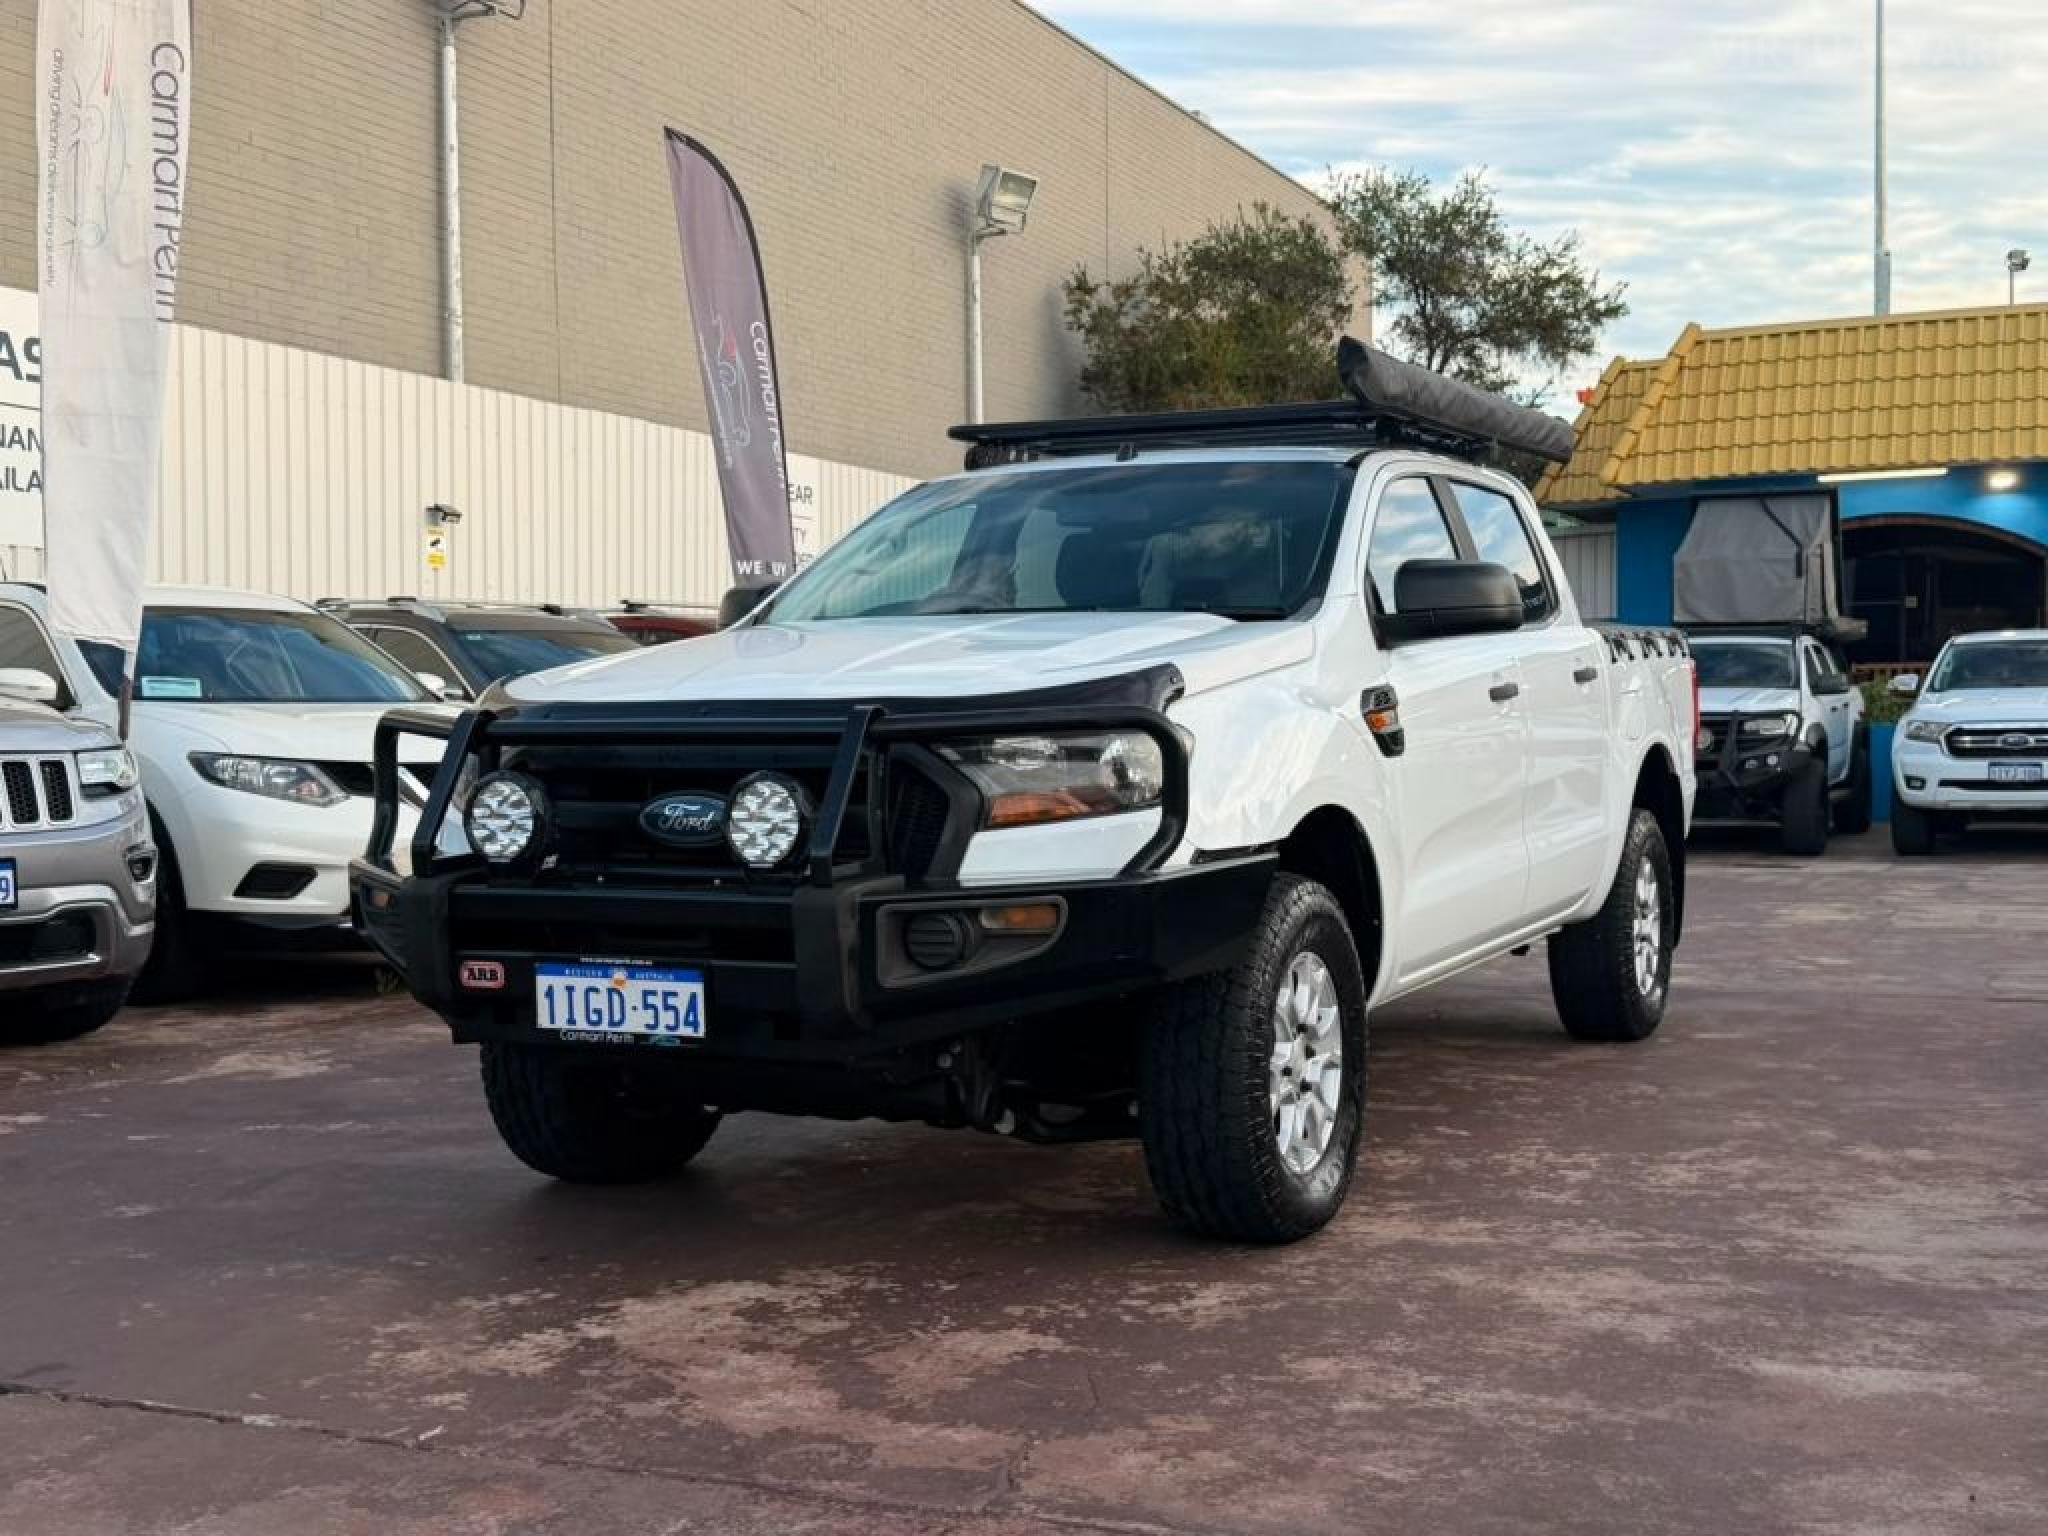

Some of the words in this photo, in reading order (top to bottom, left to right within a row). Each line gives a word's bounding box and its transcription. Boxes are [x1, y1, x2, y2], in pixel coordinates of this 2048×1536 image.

[151, 42, 185, 217] Carmart
[736, 560, 762, 575] WE
[658, 803, 715, 831] Ford
[467, 967, 499, 981] ARB
